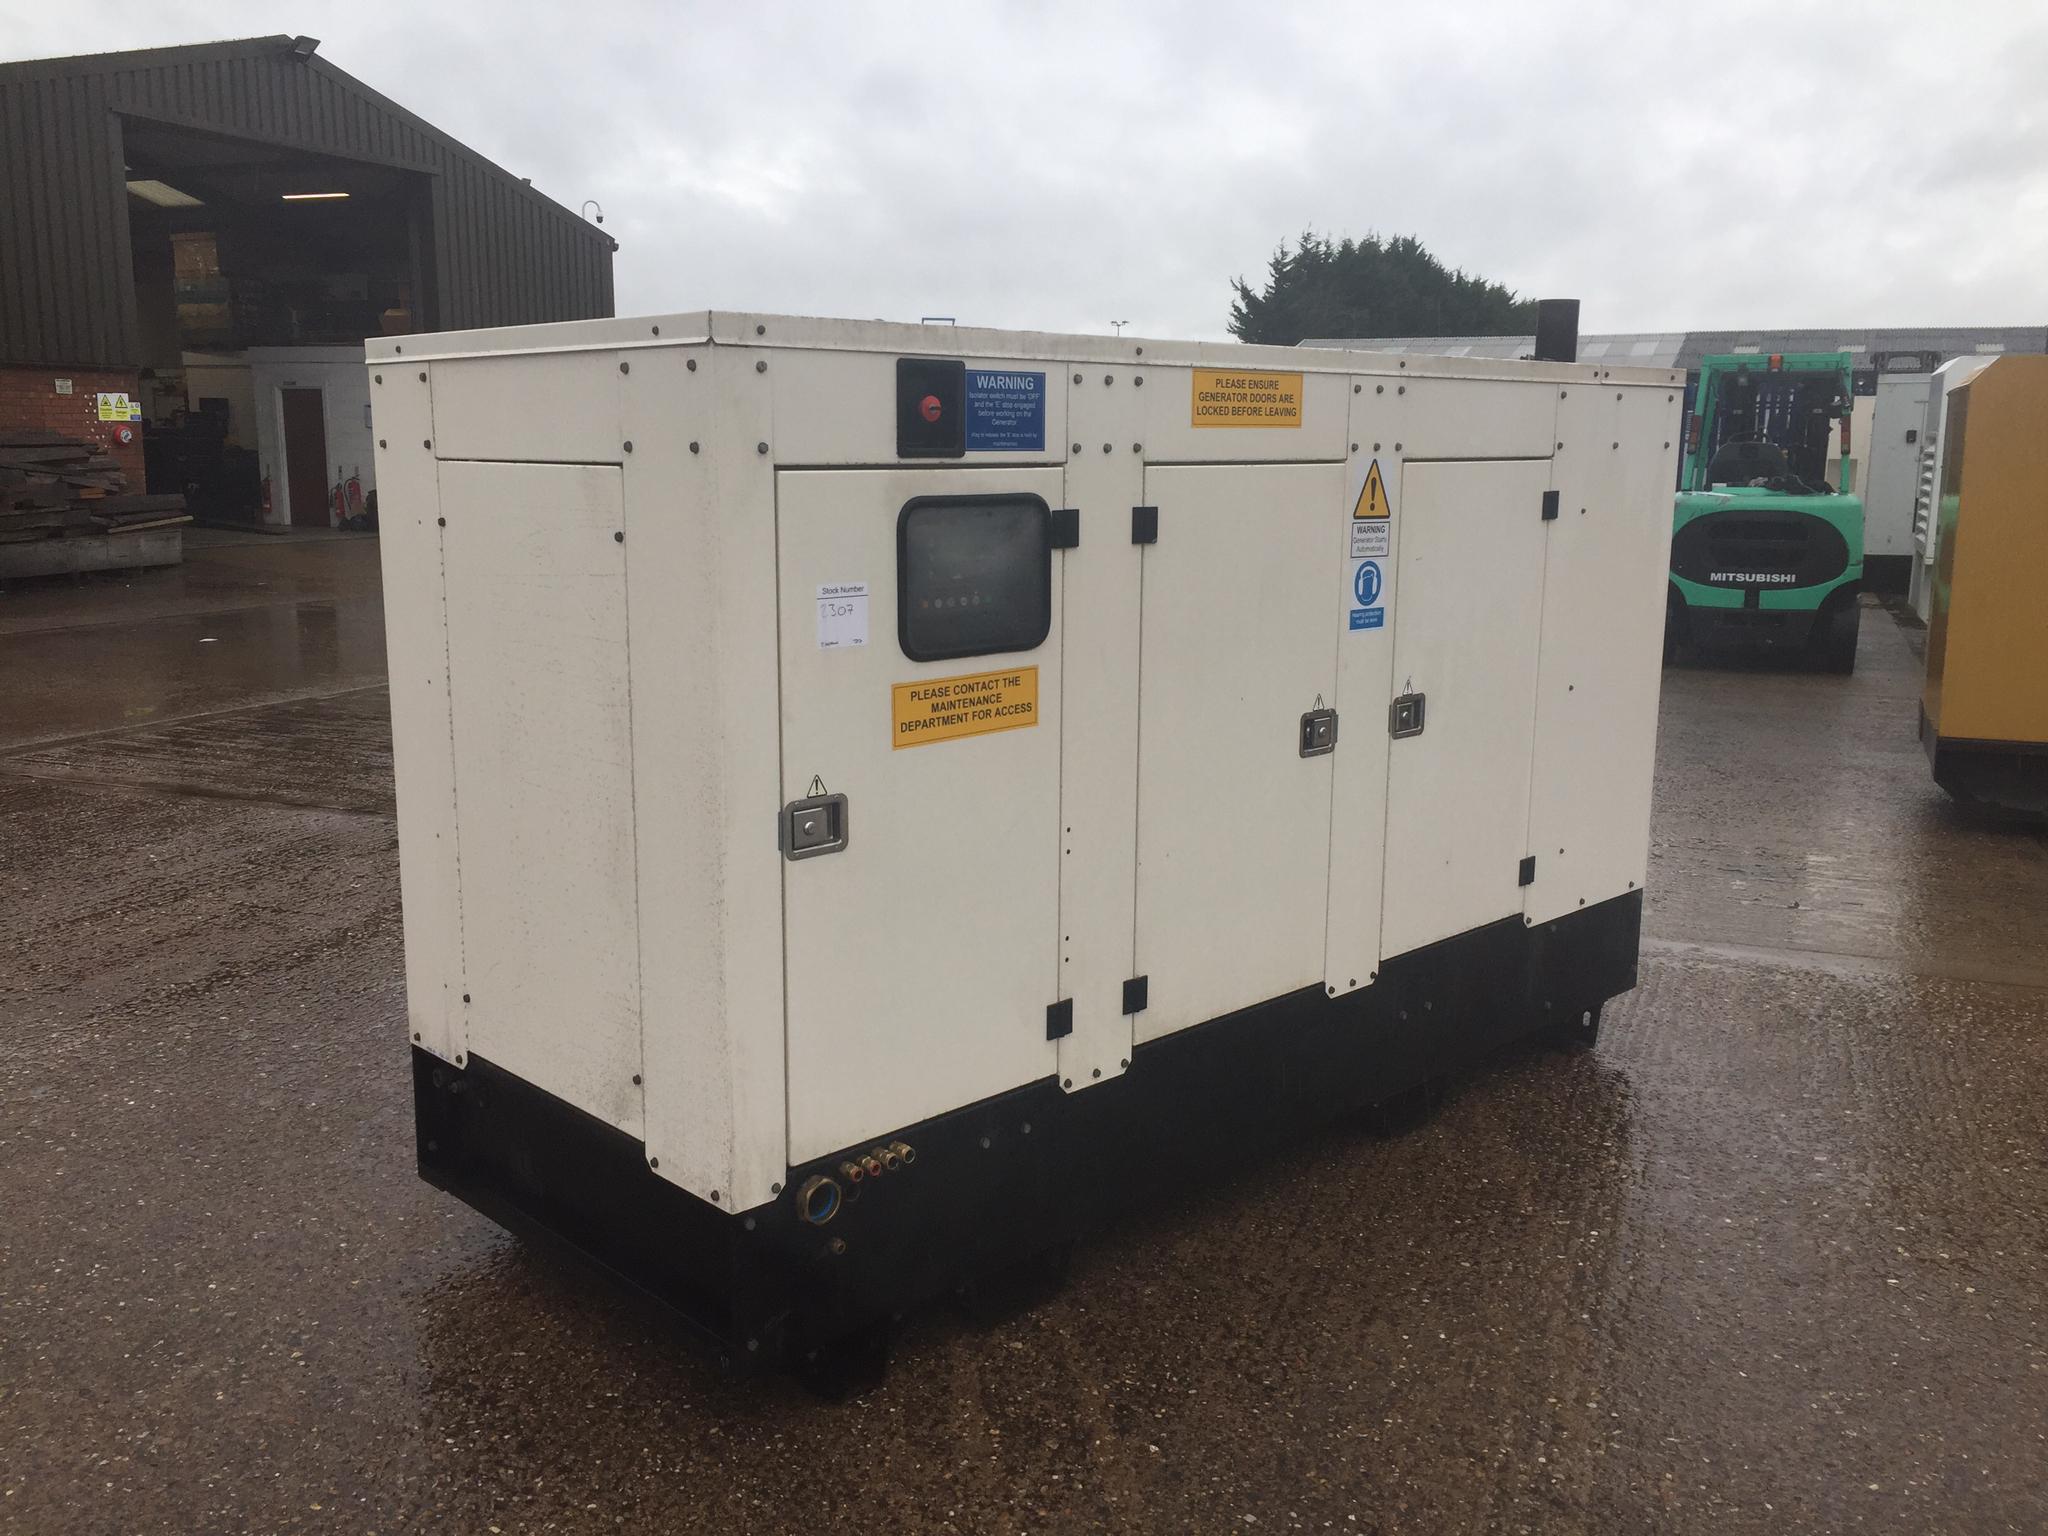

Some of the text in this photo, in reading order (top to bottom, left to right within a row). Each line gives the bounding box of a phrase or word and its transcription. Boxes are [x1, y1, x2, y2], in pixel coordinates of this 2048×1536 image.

[976, 375, 1034, 390] WARNING
[1215, 378, 1279, 390] PLEASE ENSURE
[1198, 392, 1294, 404] GENERATOR DOORS ARE
[1196, 405, 1297, 417] LOCKED BEFORE LEAVING
[1356, 525, 1386, 534] WARNING
[1710, 572, 1796, 583] MITSUBISHI
[822, 587, 839, 595] Stock
[910, 676, 1021, 702] PLEASE CONTACT THE
[931, 692, 1003, 713] MAINTENANCE
[900, 702, 1032, 733] DEPARTMENT FOR ACCESS
